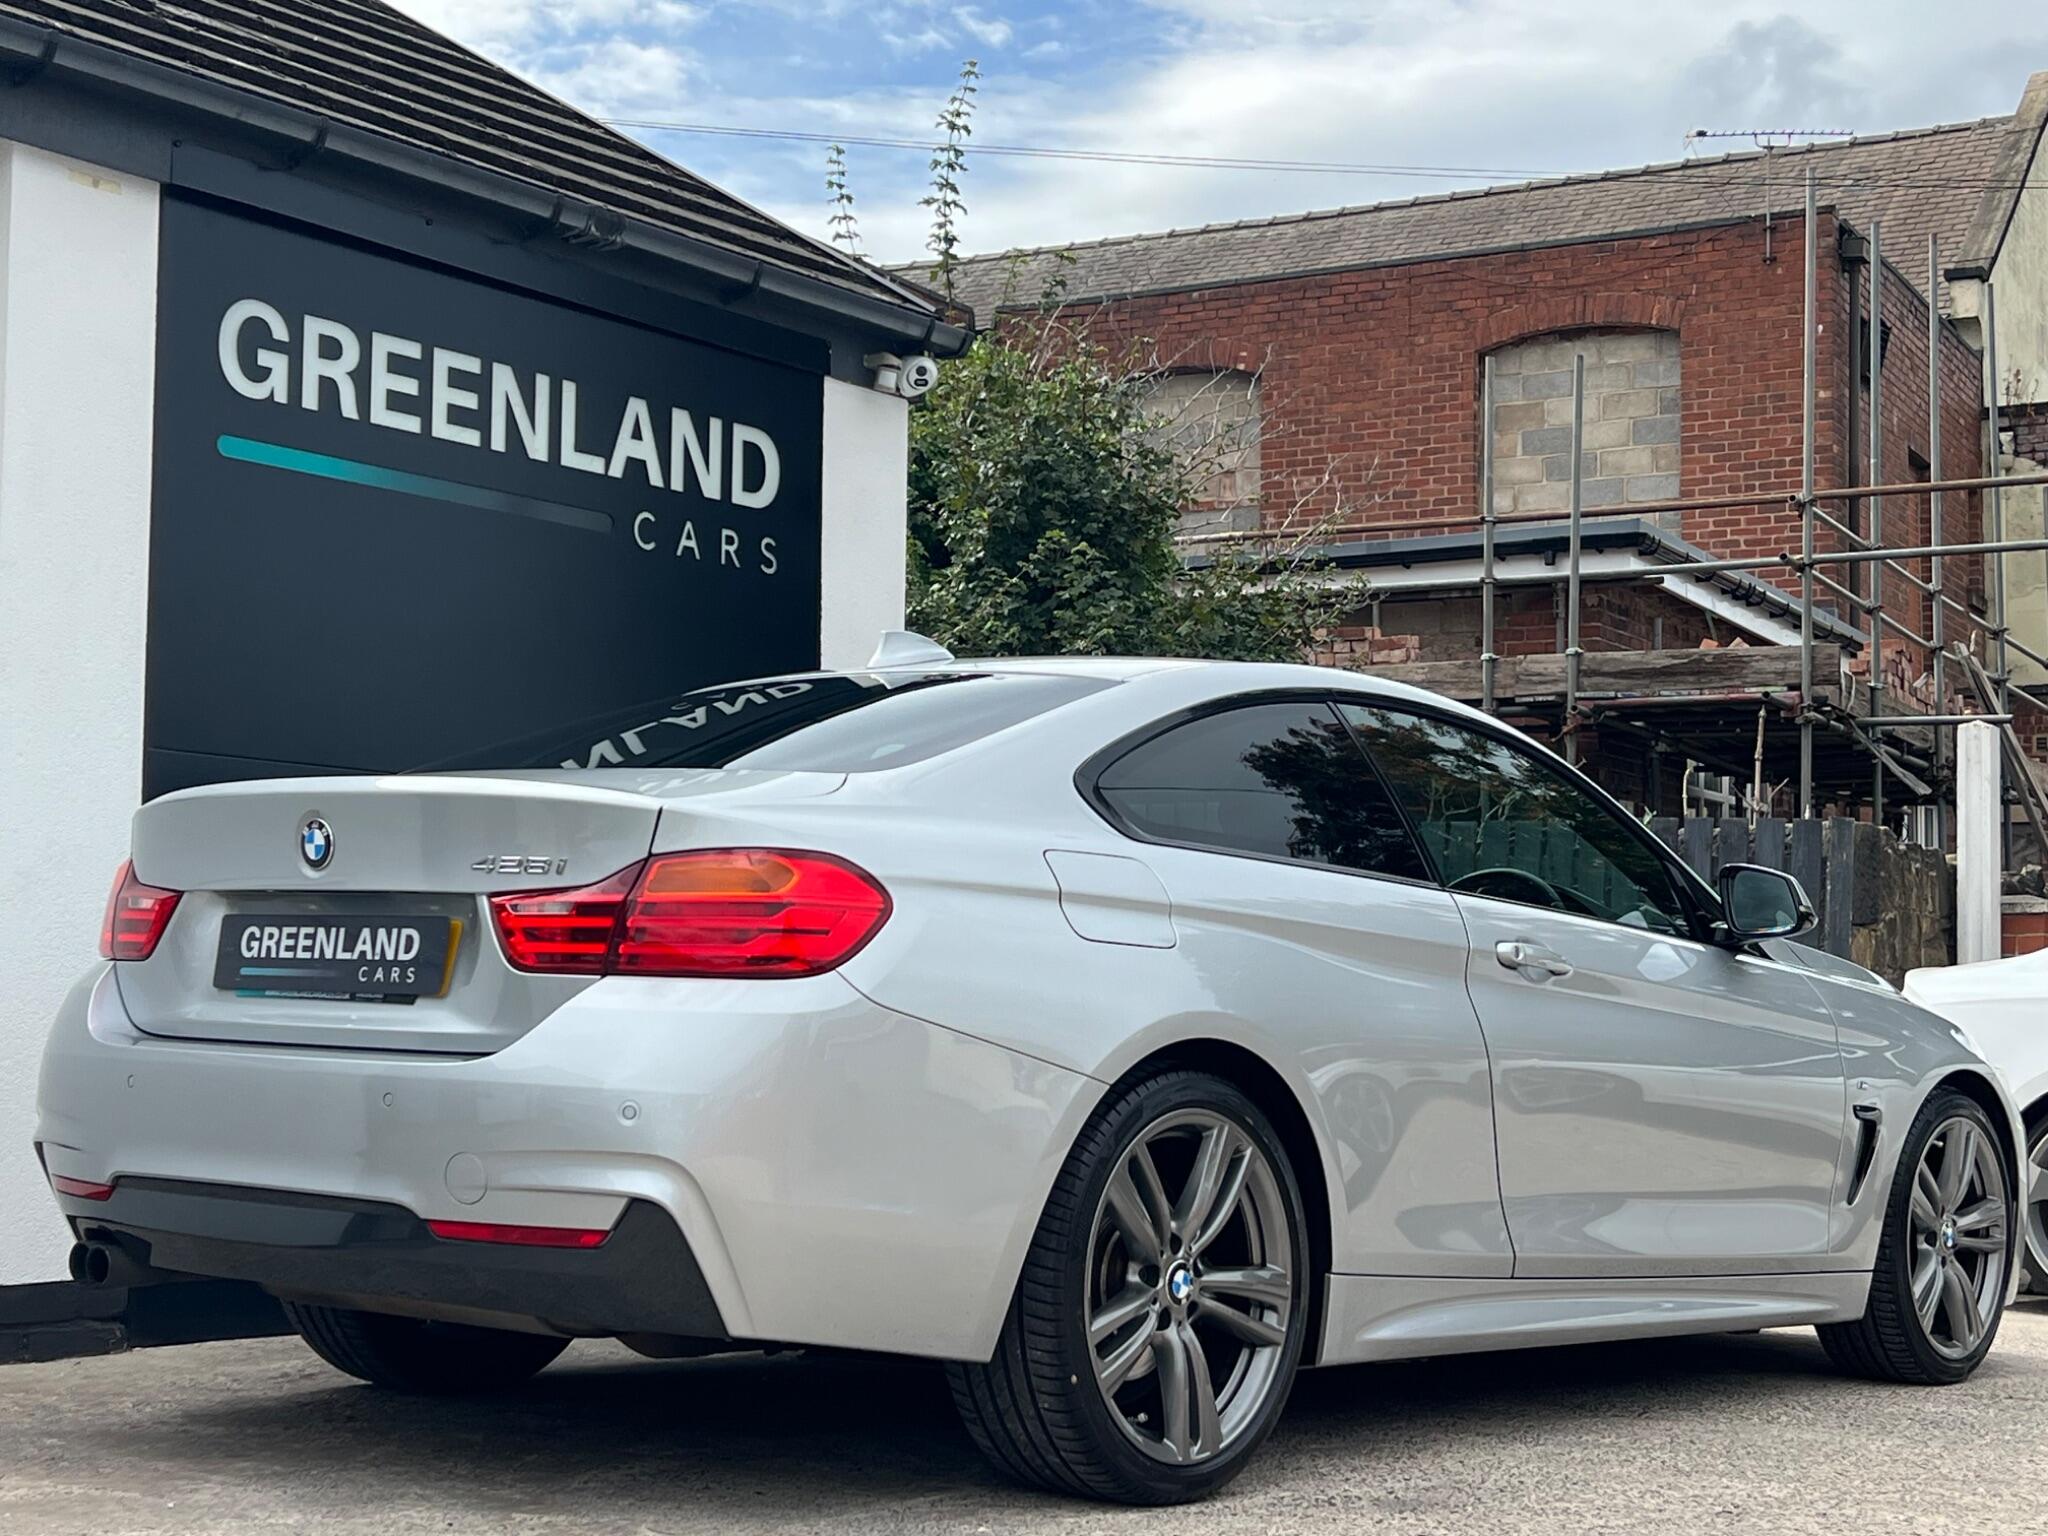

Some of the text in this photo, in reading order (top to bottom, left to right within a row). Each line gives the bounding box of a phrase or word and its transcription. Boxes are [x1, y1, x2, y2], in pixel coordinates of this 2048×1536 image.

[218, 298, 781, 510] GREENLAND
[633, 510, 778, 575] CARS
[240, 925, 420, 961] GREENLAND
[358, 966, 416, 983] CARS
